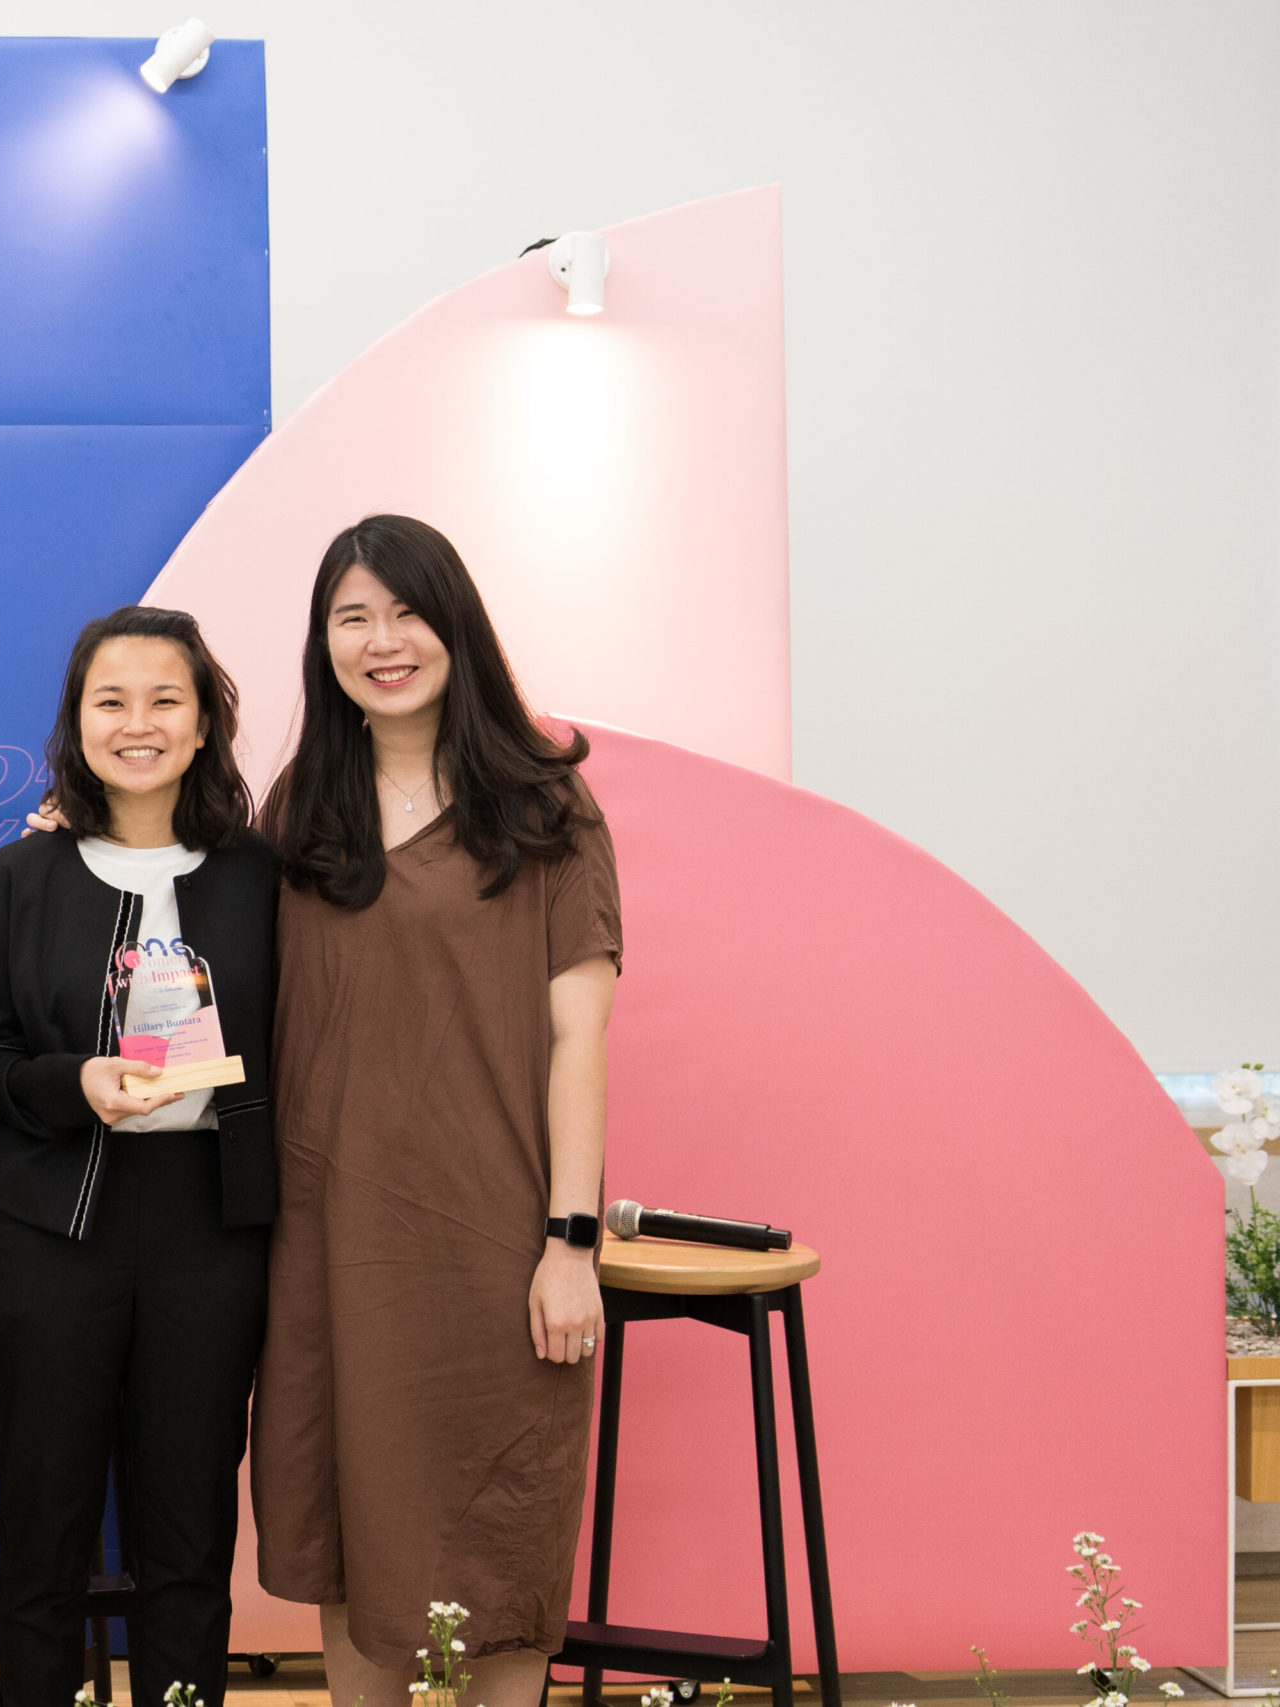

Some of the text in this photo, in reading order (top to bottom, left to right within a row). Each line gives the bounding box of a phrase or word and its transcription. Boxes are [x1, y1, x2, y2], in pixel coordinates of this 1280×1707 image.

[116, 965, 201, 988] wih Impact
[133, 1016, 202, 1034] Hillary Buntara
